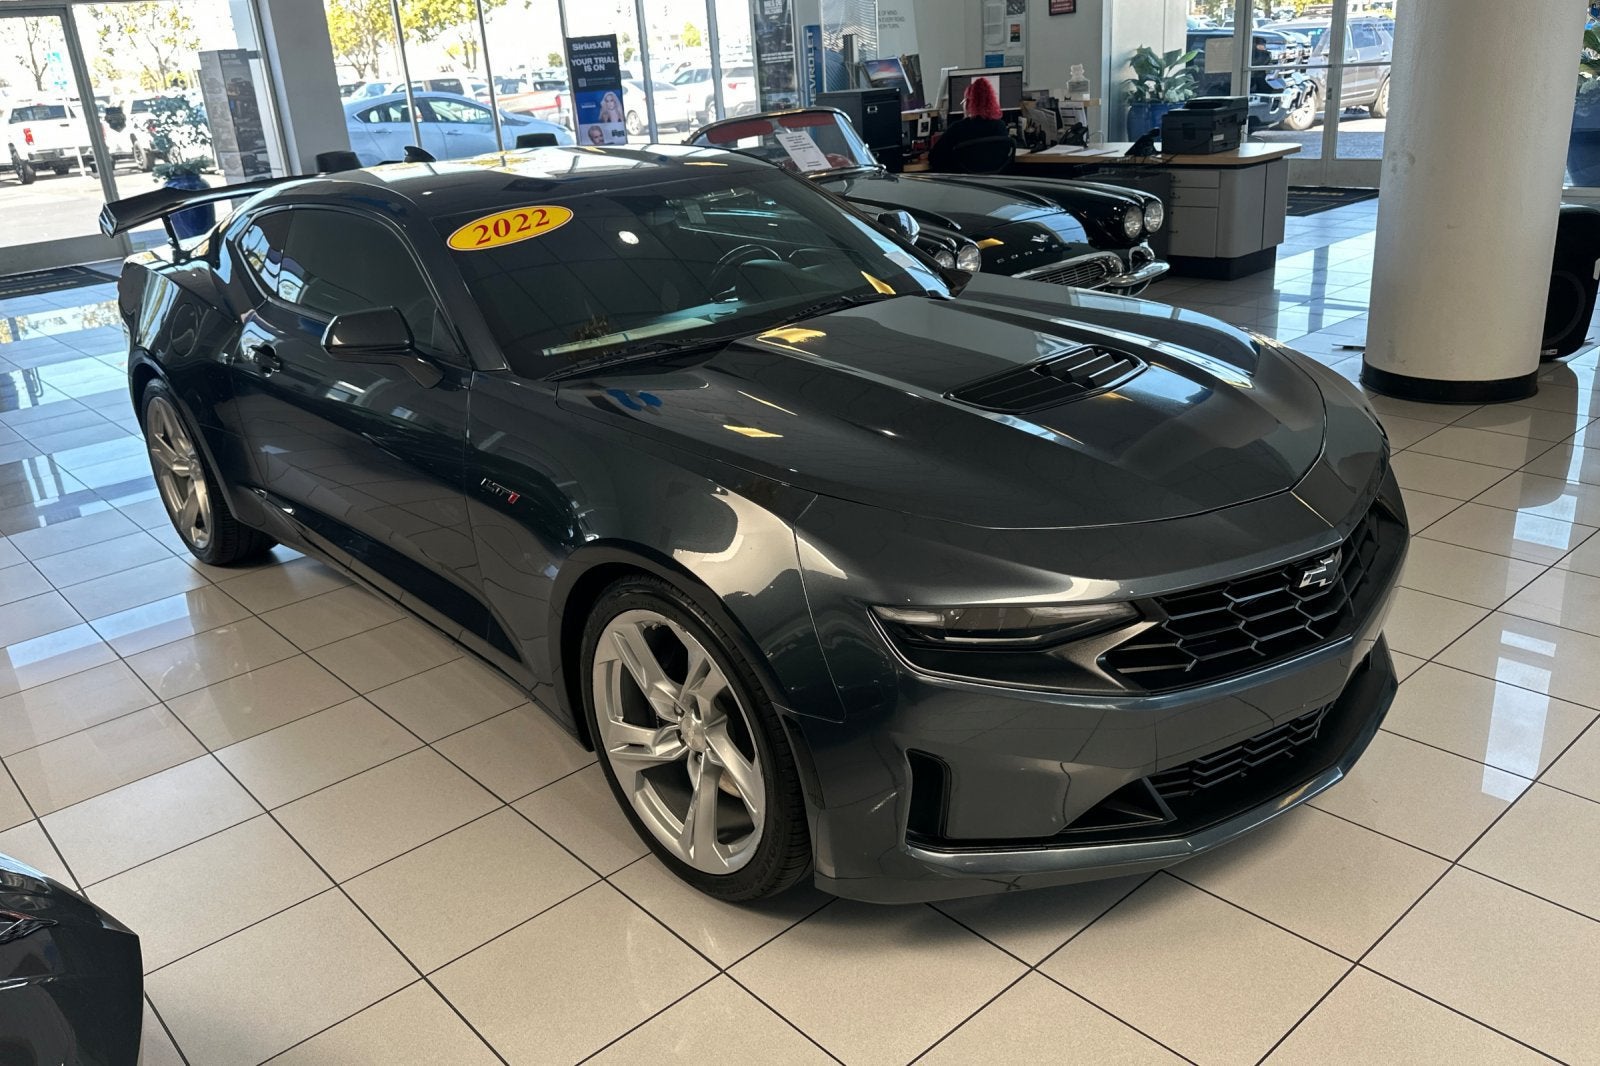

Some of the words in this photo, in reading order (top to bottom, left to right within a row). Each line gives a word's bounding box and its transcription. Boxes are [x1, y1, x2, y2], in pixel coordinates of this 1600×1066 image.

[572, 41, 612, 51] SiriusXM
[571, 57, 593, 67] YOUR
[593, 56, 617, 64] TRIAL
[593, 64, 606, 72] ON
[806, 29, 817, 108] HEVROLET
[473, 208, 550, 245] 2022
